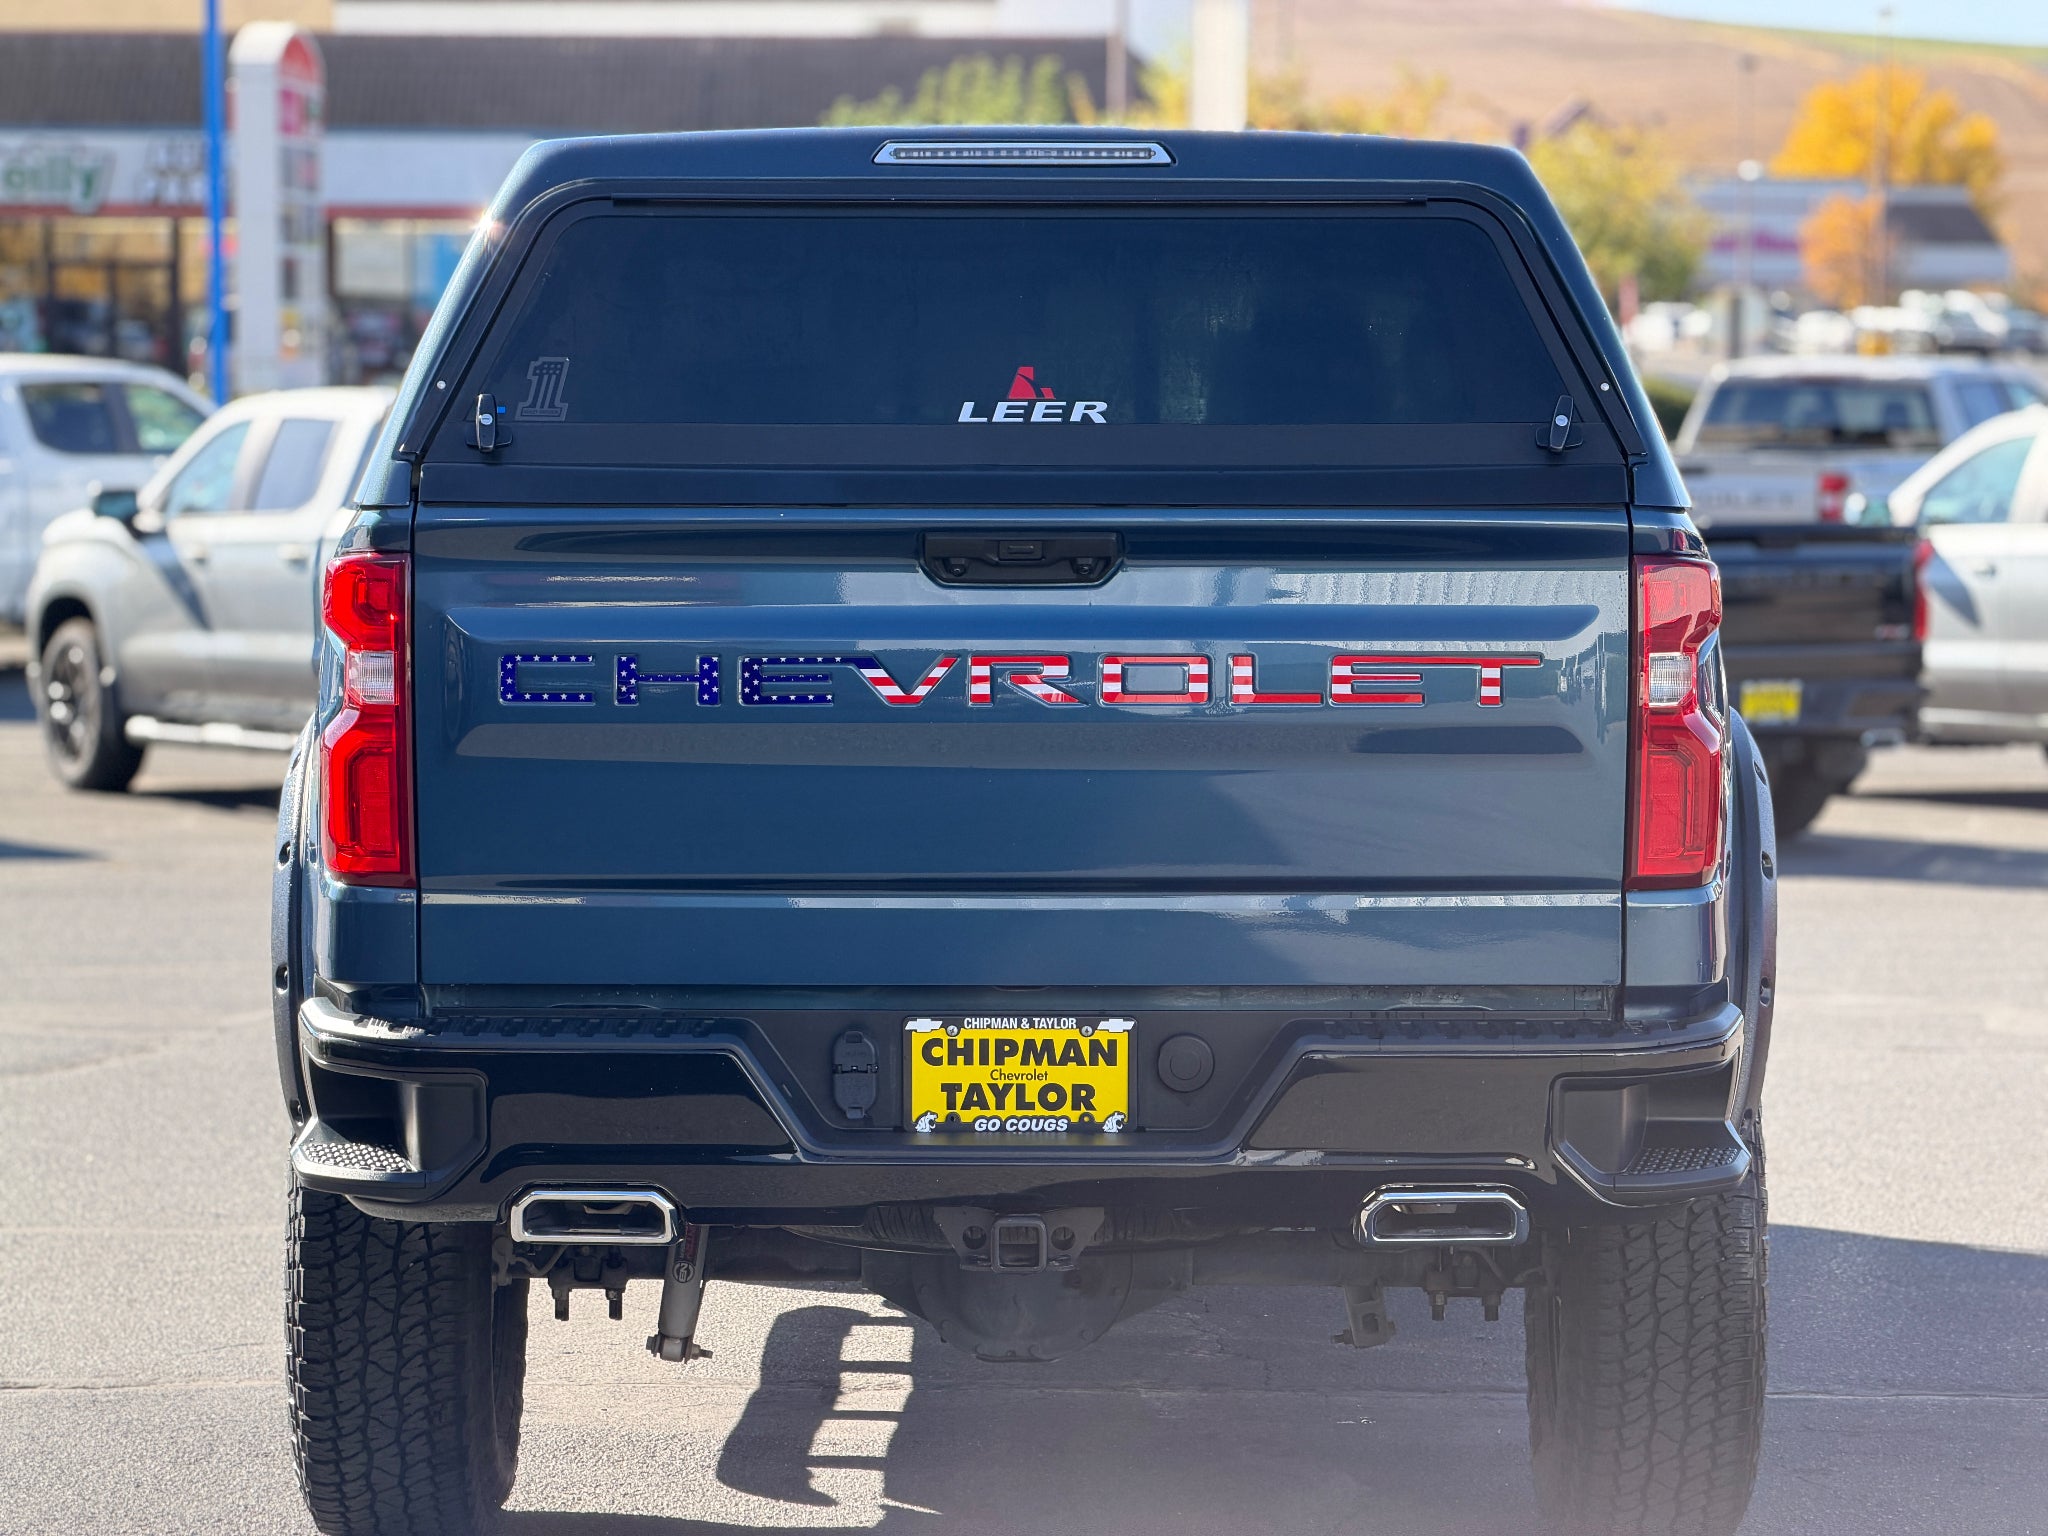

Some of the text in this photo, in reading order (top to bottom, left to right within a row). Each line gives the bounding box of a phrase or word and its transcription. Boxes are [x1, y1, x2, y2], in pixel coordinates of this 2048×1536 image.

[957, 401, 1108, 424] LEER
[499, 654, 1544, 707] CHEVROLET
[963, 1017, 1077, 1029] CHIPMAN & TAYLOR
[921, 1037, 1118, 1067] CHIPMAN
[990, 1068, 1049, 1081] Chevrolet
[940, 1082, 1098, 1111] TAYLOR
[974, 1118, 1069, 1132] GO COUGS
